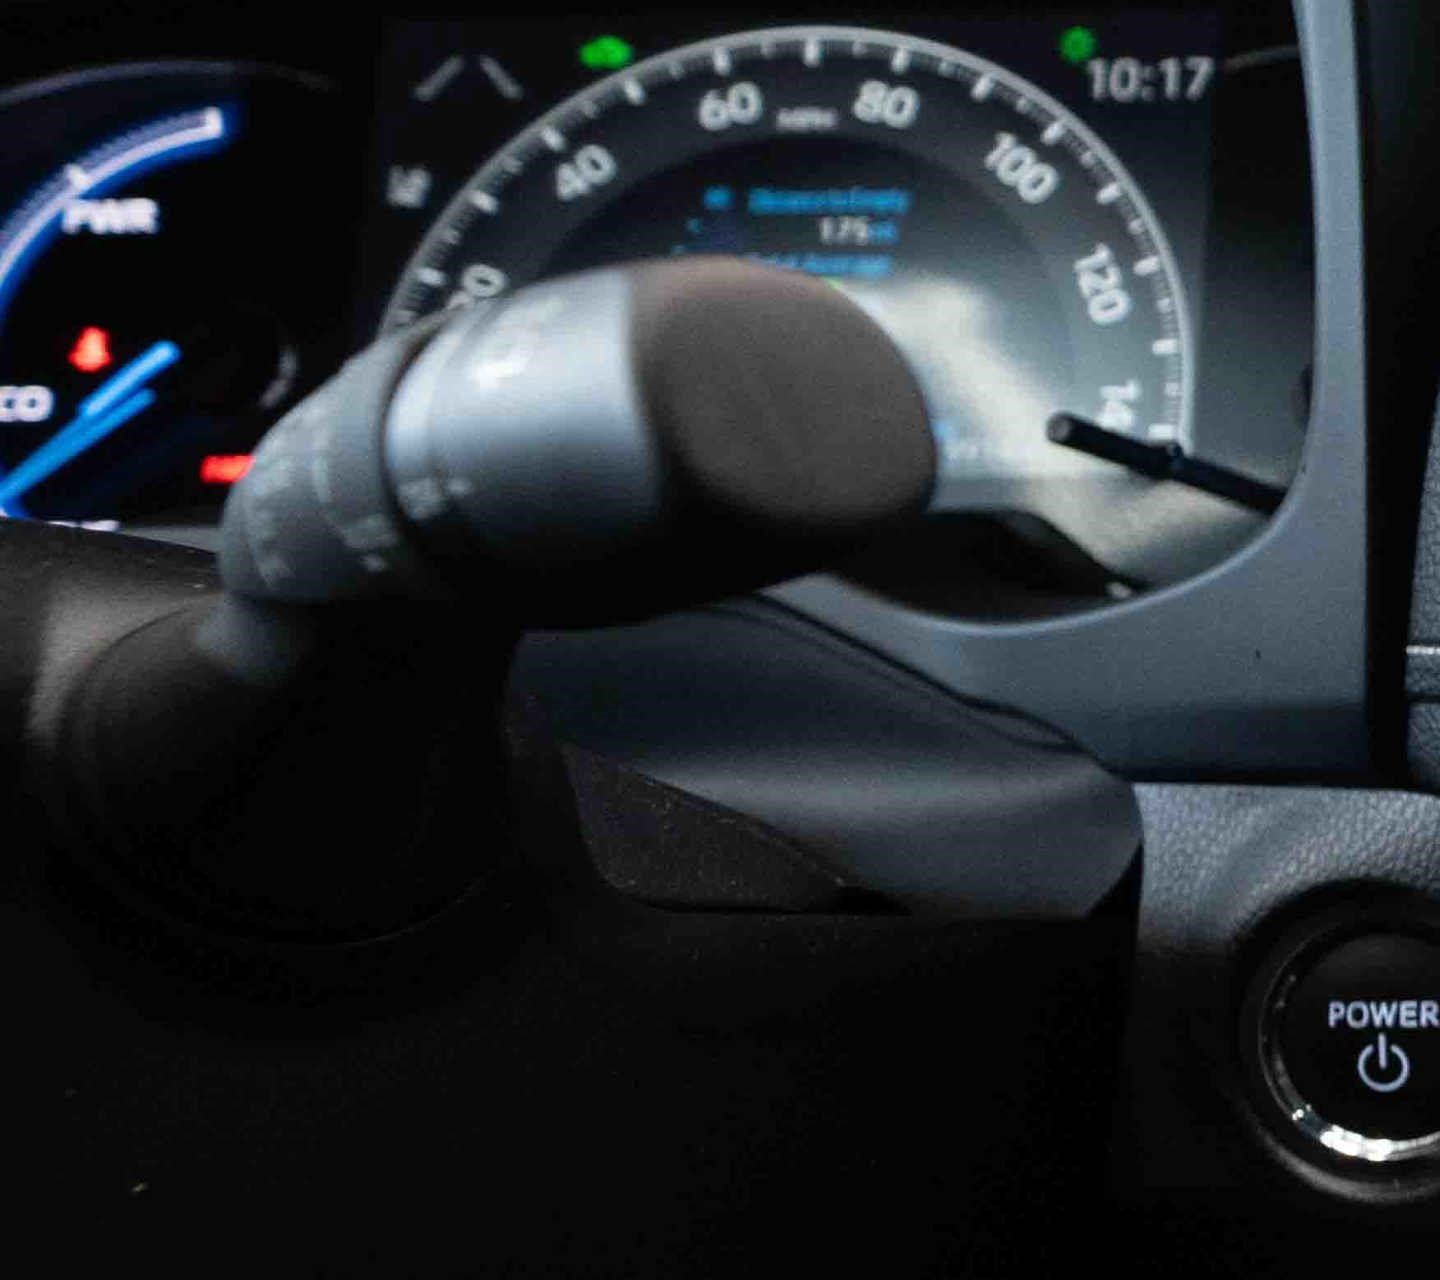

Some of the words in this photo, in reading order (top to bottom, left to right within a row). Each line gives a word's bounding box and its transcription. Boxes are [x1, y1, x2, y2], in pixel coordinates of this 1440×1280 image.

[1086, 56, 1215, 103] 10:17
[698, 82, 762, 131] 60
[853, 81, 920, 128] 80
[555, 144, 616, 201] 40
[985, 132, 1060, 204] 100
[62, 197, 159, 234] PWR
[1074, 243, 1131, 325] 120
[0, 385, 54, 422] CO
[1100, 379, 1141, 427] 14
[1327, 1000, 1440, 1028] POWER
